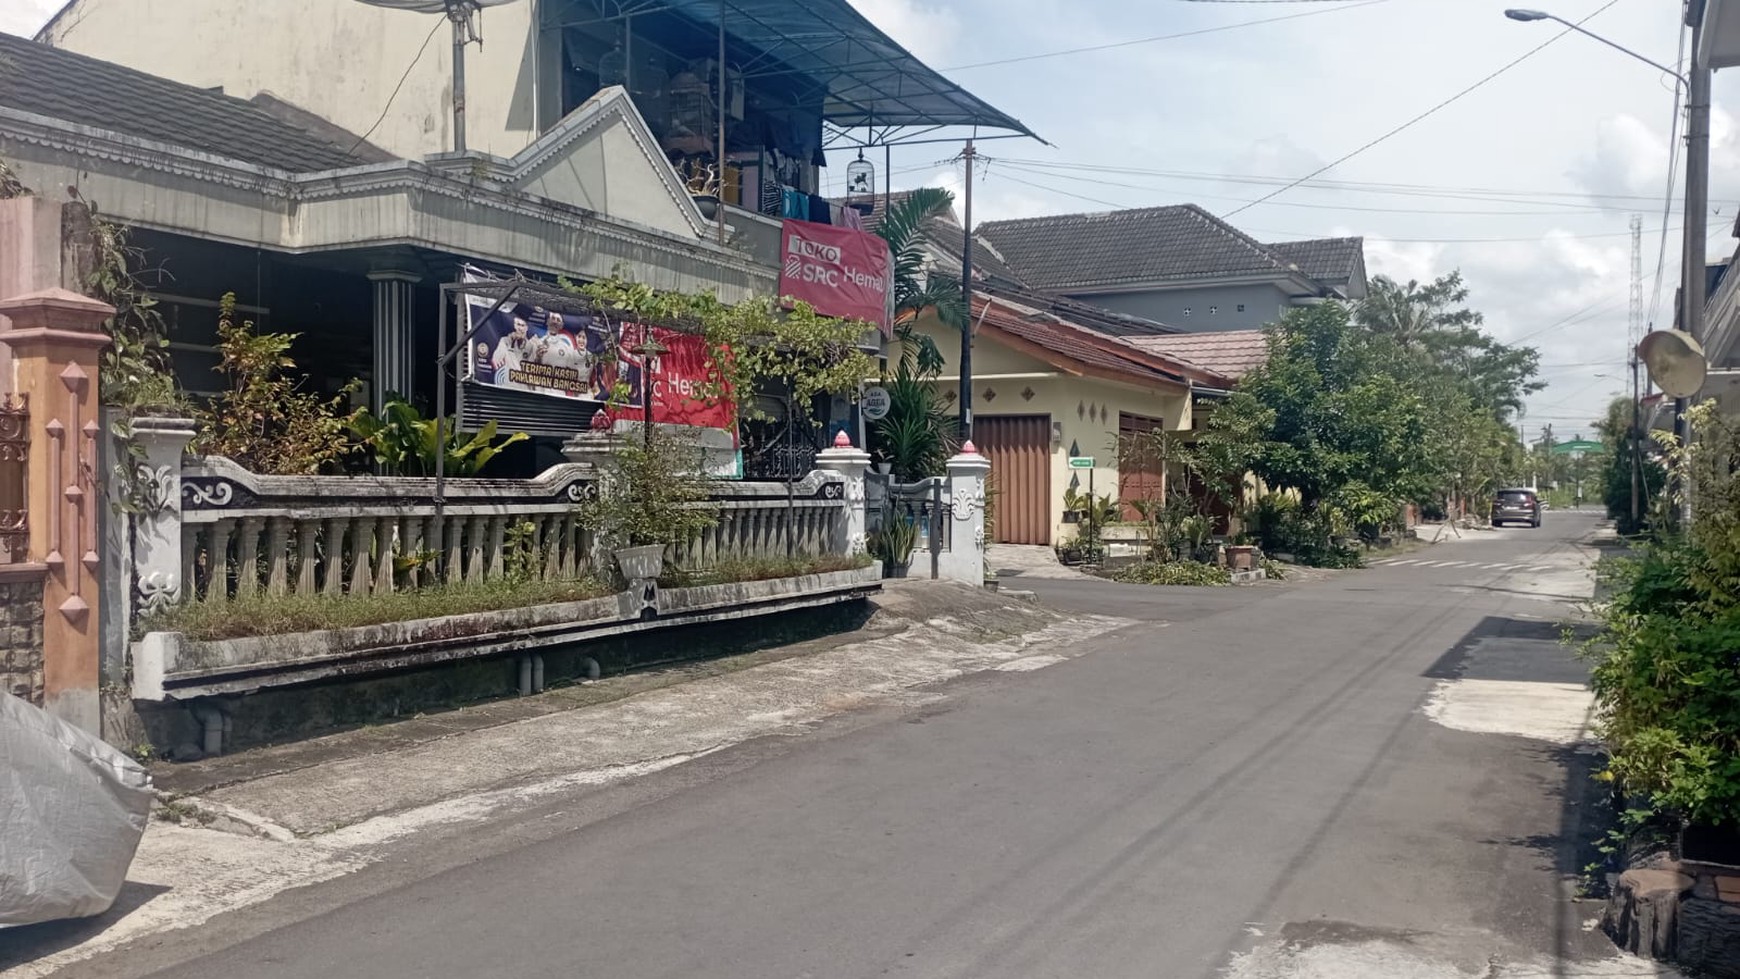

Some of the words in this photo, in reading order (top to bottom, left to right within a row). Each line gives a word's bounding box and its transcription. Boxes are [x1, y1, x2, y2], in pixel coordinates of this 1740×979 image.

[794, 237, 837, 262] TOKO
[803, 263, 838, 288] SRC
[510, 370, 552, 388] PAHLAWAN
[520, 361, 552, 376] TERIMA
[555, 366, 578, 381] KASIH
